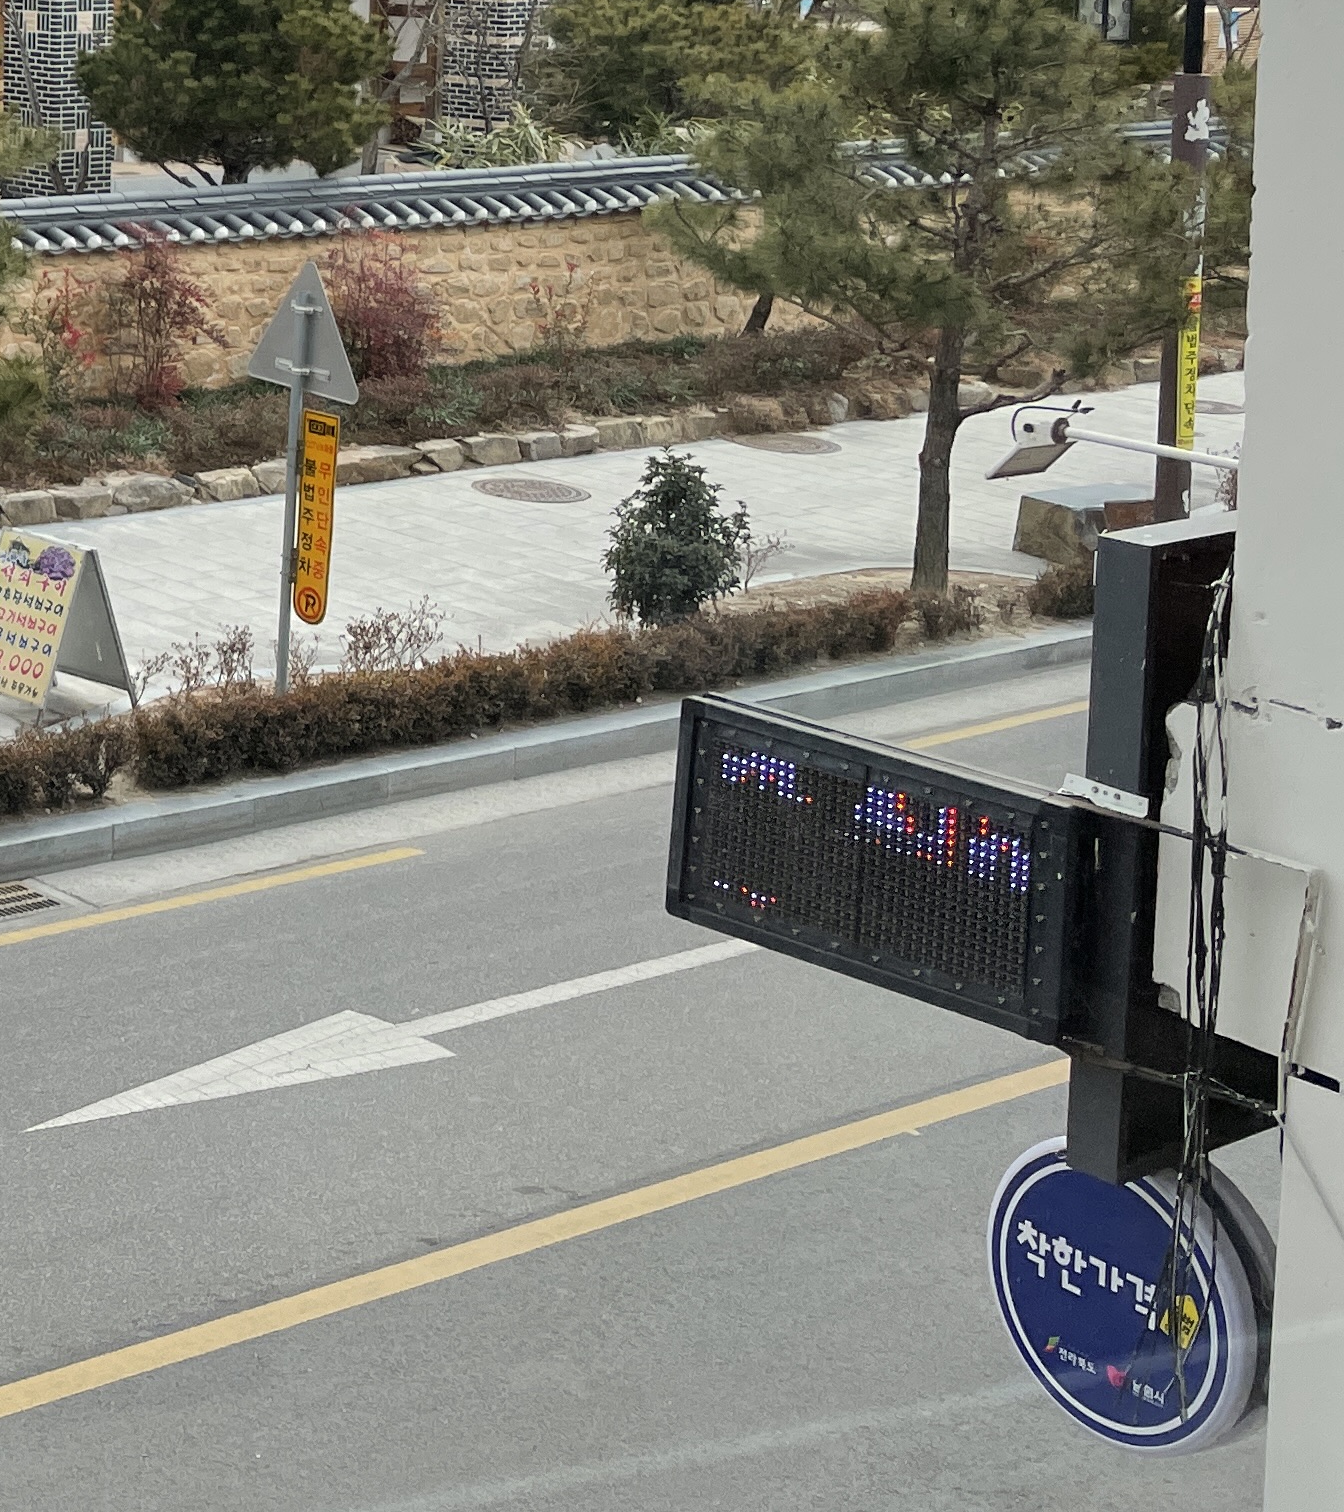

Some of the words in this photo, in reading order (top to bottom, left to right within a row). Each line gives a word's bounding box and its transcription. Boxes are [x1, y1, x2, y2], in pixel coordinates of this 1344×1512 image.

[299, 458, 317, 576] 불법주정차
[312, 461, 331, 580] 무인단속중
[1017, 1219, 1157, 1331] 착한가격
